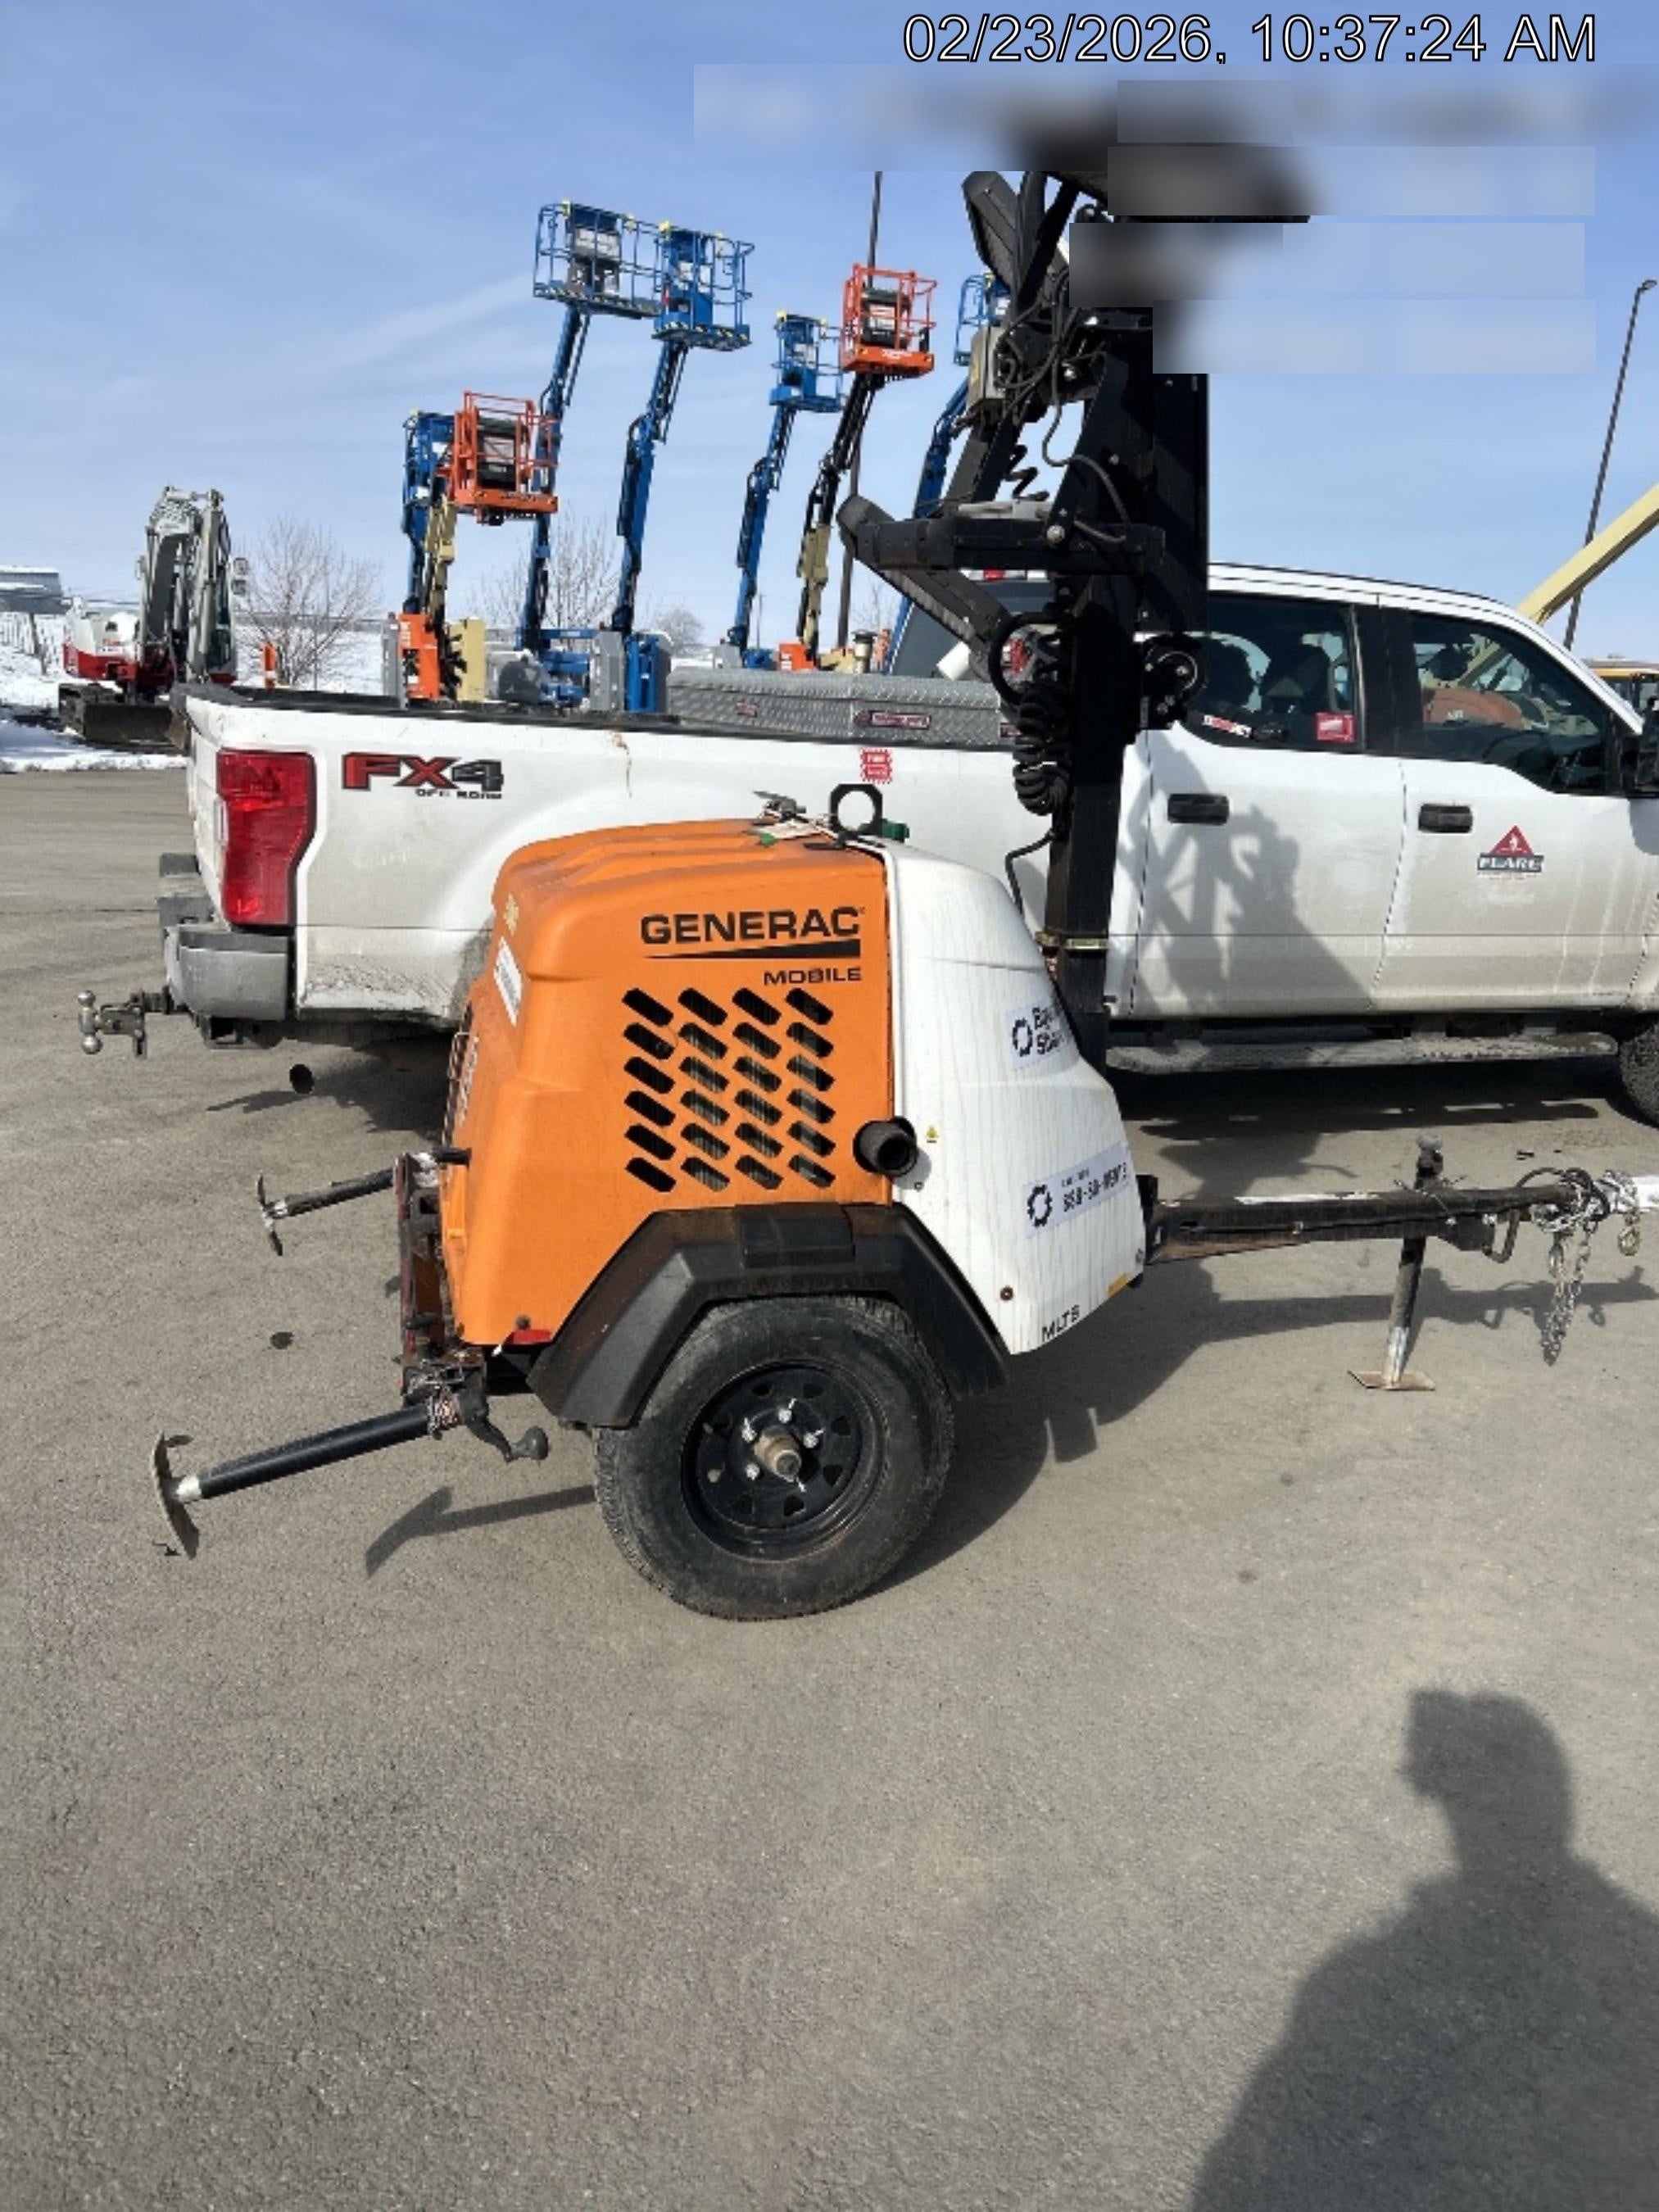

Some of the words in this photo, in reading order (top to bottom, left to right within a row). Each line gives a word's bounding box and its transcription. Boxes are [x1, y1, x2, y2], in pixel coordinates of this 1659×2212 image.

[342, 751, 504, 792] FX4
[640, 906, 860, 945] GENERAC
[764, 966, 863, 986] MOBILE
